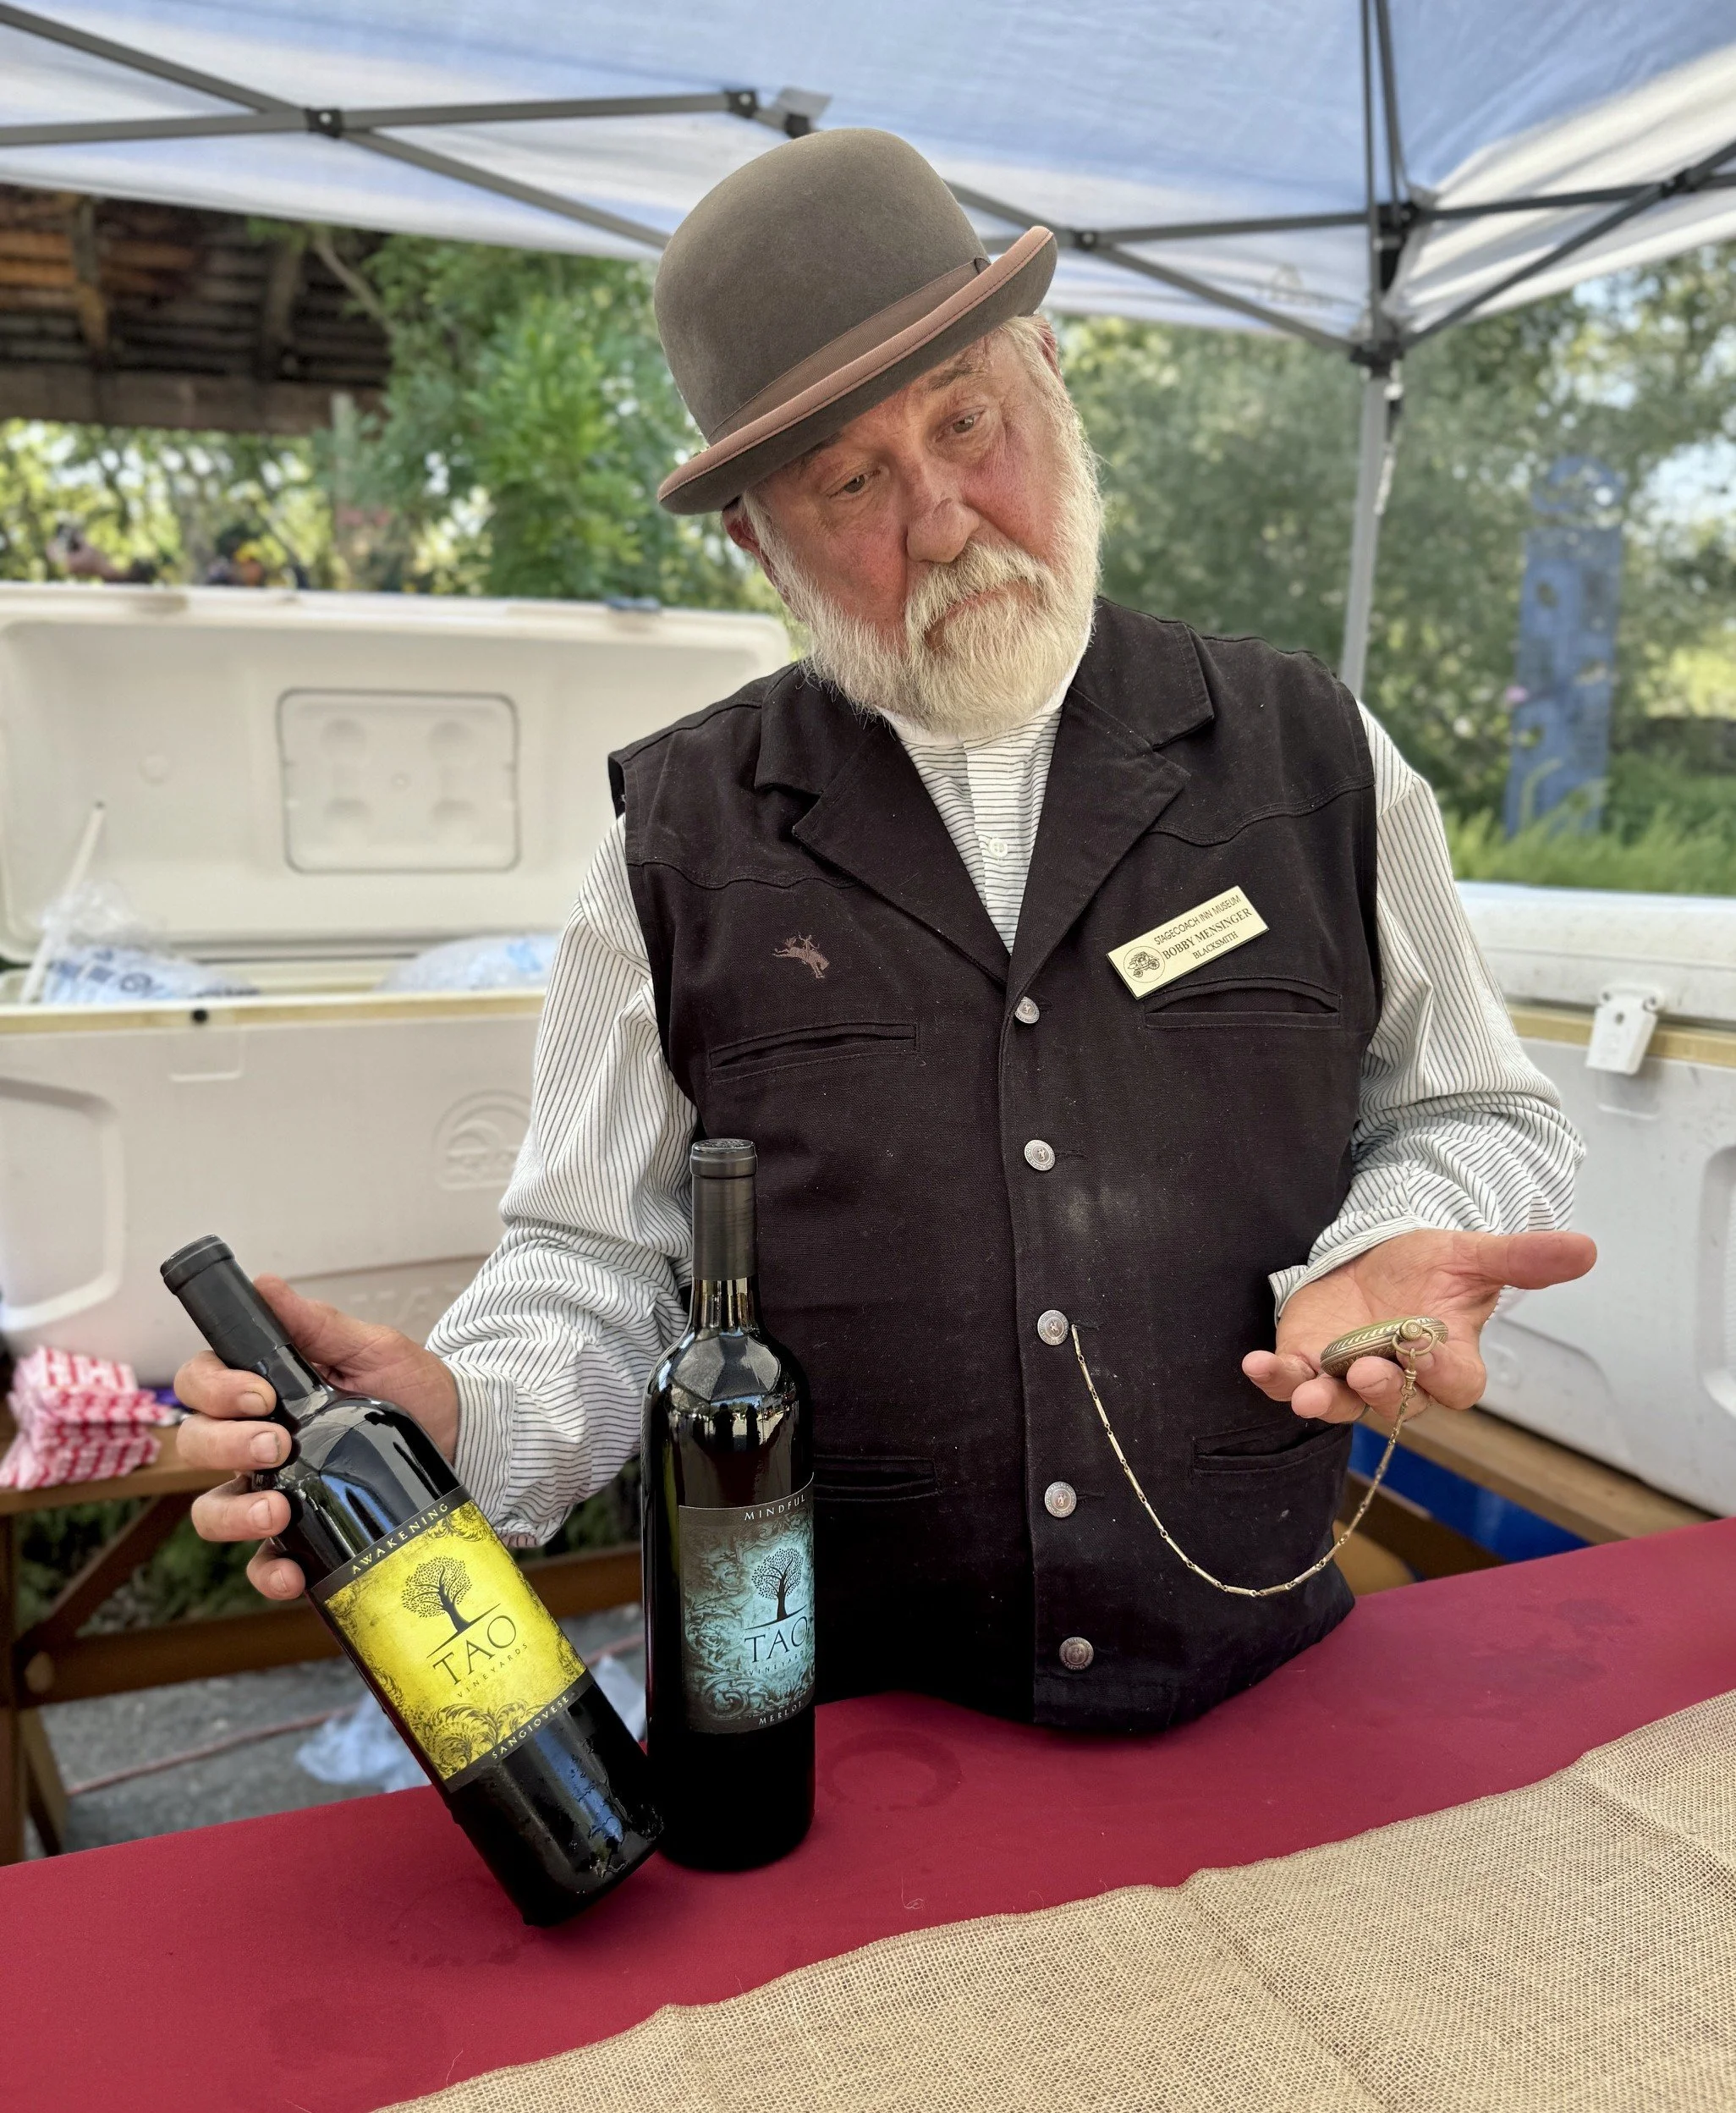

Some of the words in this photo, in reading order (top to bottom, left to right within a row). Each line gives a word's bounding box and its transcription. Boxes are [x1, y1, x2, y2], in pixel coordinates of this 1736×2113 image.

[1153, 917, 1200, 945] STAGECOACH
[1198, 910, 1213, 923] INN
[1211, 894, 1242, 917] MUSEUM
[1162, 936, 1195, 960] BOBBY
[1195, 907, 1253, 944] MENSINGER
[1192, 931, 1239, 960] BLACKSMITH
[744, 1494, 805, 1521] MINDFUL
[351, 1502, 450, 1575] AWAKENING
[432, 1615, 518, 1686] TAO
[744, 1616, 808, 1664] TAO
[457, 1642, 529, 1698] VINEYARDS
[492, 1694, 570, 1759] SANGIOVESE
[758, 1700, 801, 1726] MERLOT
